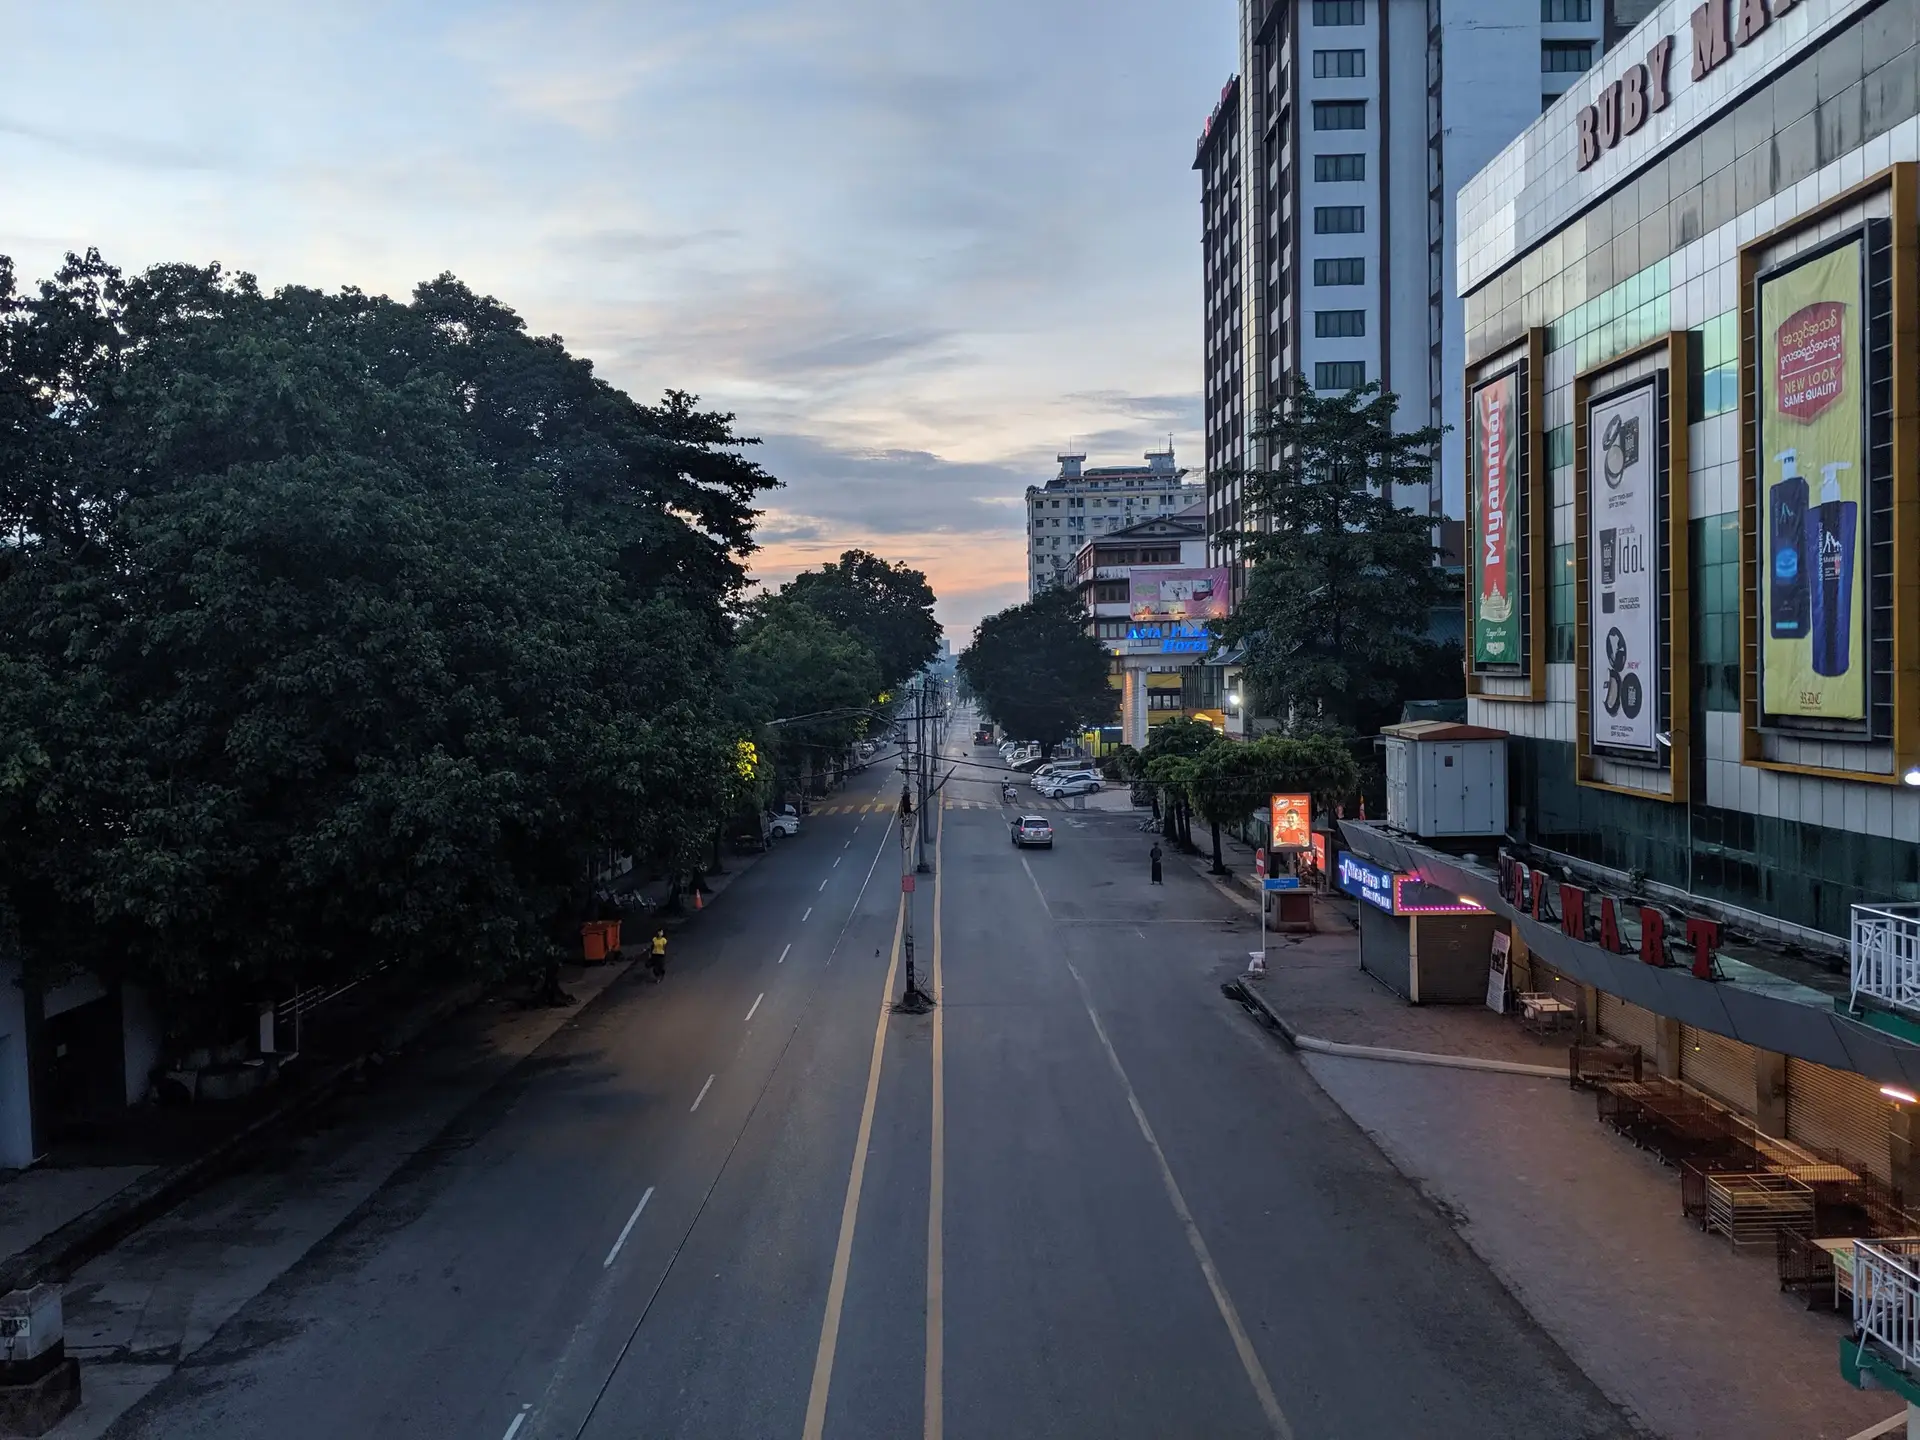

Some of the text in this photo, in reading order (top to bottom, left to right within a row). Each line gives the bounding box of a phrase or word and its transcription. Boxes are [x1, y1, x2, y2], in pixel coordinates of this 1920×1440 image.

[1576, 35, 1675, 172] RUBY
[1784, 367, 1836, 395] NEW LOOK
[1784, 381, 1837, 408] SAME QUALITY
[1485, 396, 1503, 566] Myanmar
[1127, 626, 1161, 639] ASIA
[1162, 639, 1209, 653] HOTEL
[1498, 848, 1550, 922] UBY
[1558, 882, 1724, 982] MART
